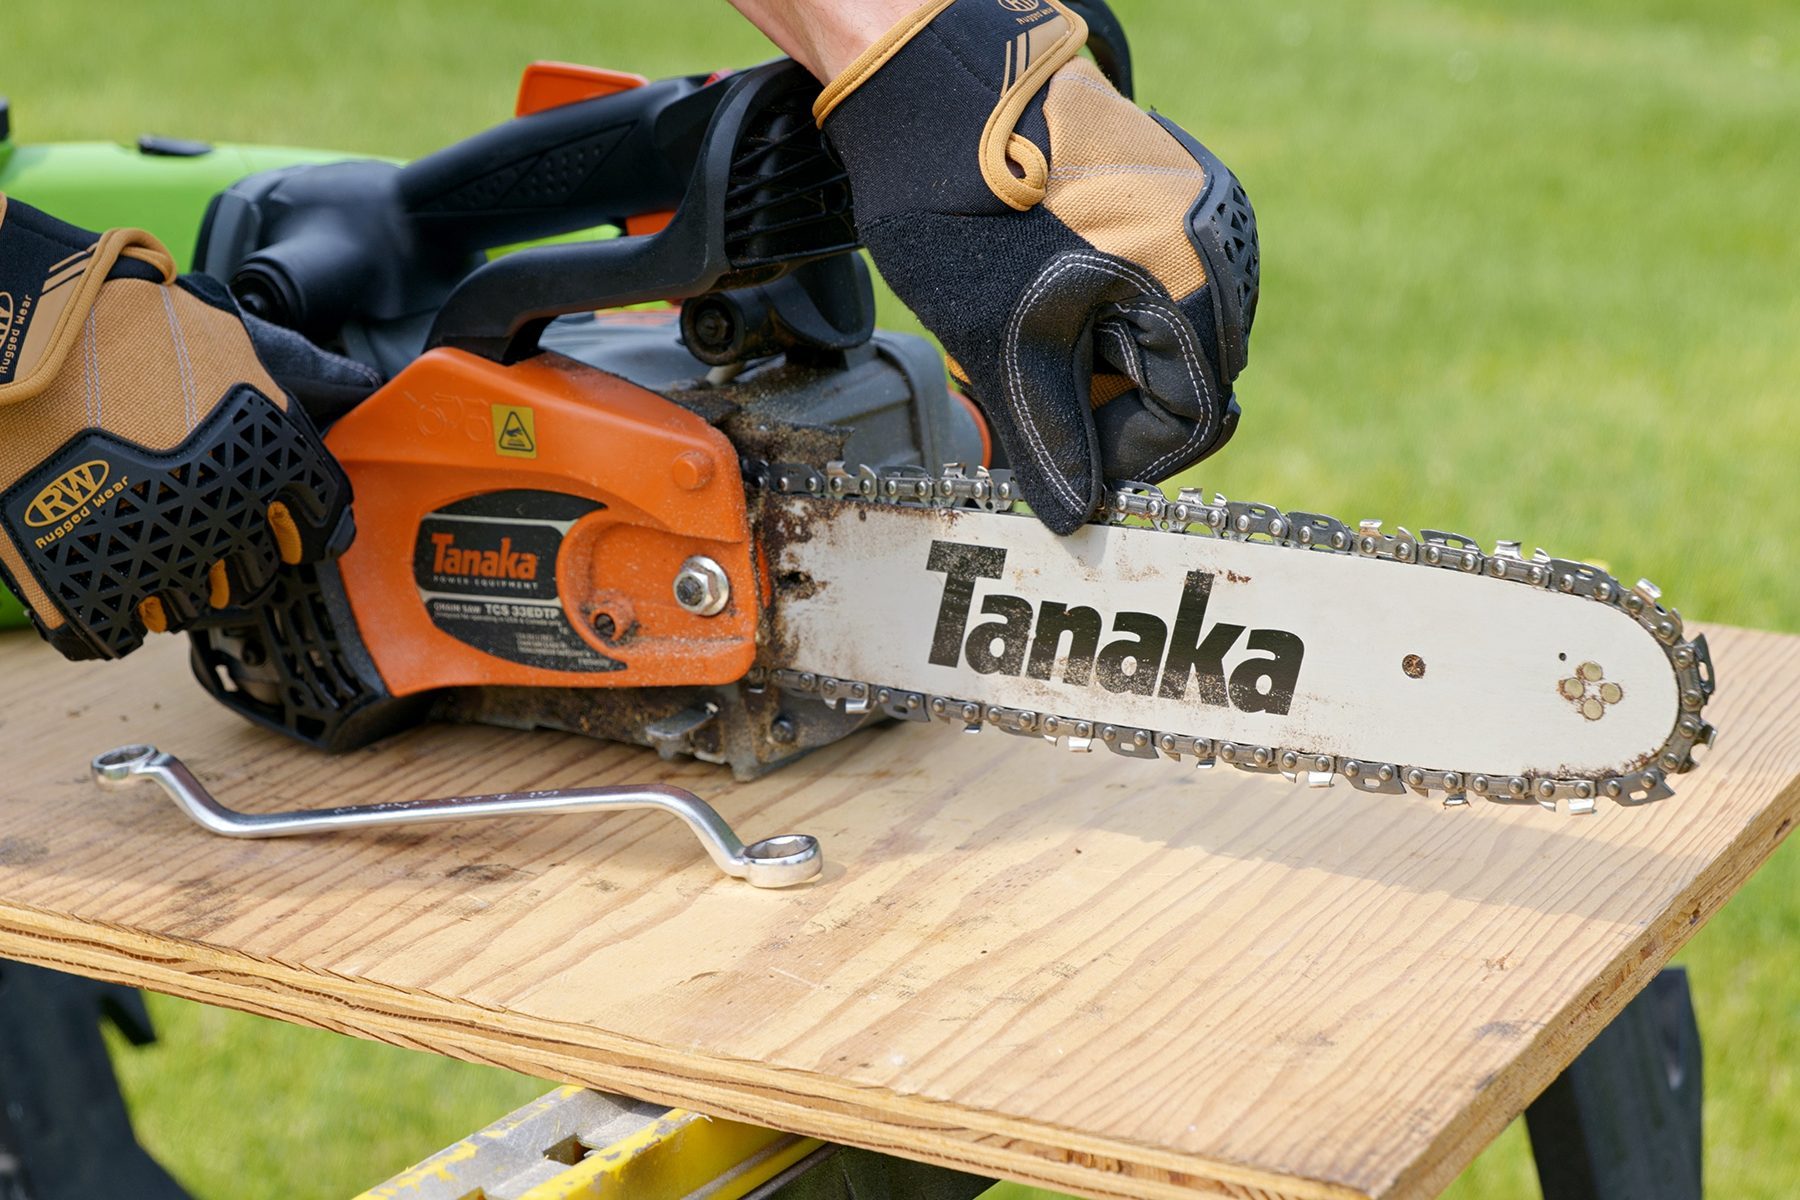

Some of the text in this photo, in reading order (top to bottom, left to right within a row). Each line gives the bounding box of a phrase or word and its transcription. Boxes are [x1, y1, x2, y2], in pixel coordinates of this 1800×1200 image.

[0, 328, 20, 374] Rugged
[15, 294, 33, 325] Wear
[31, 465, 99, 522] RW
[35, 475, 128, 549] Rugged Wear
[431, 532, 538, 580] Tanaka
[433, 575, 539, 590] POWER EQUIPMENT
[484, 603, 509, 617] TCS
[926, 540, 1305, 716] Tanaka
